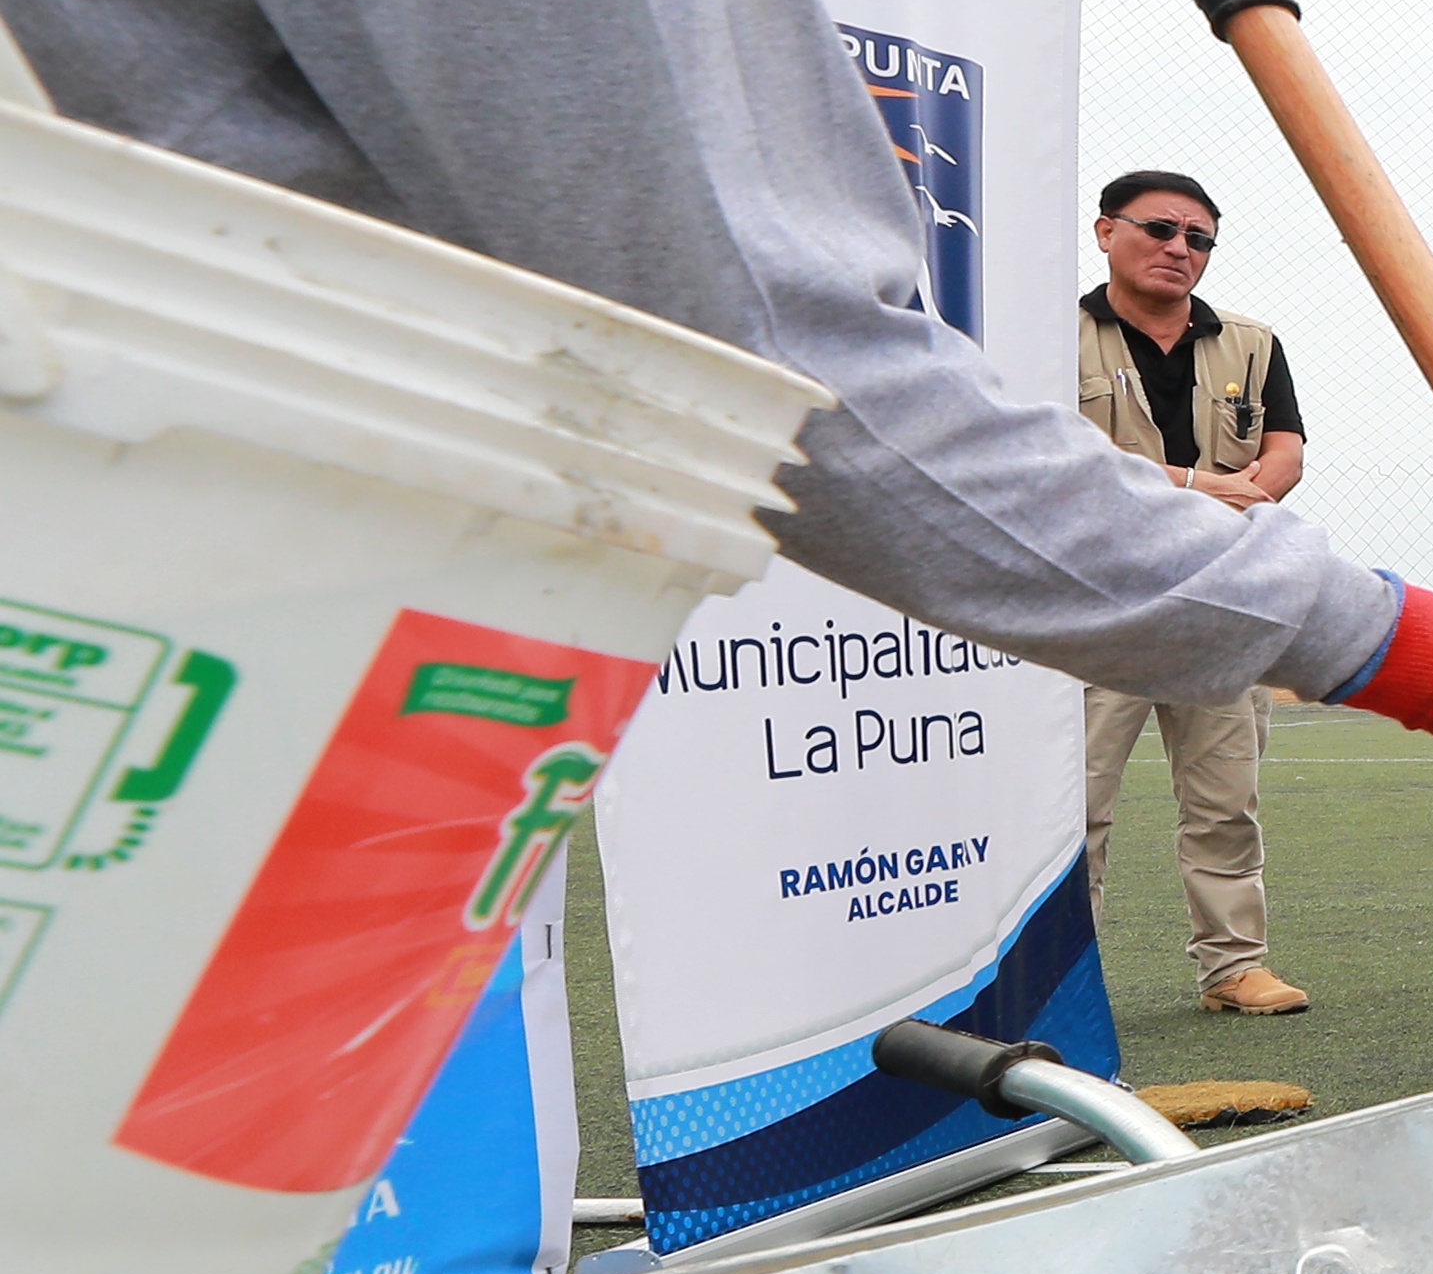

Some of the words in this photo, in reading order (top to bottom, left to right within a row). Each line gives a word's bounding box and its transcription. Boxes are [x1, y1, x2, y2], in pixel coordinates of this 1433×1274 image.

[764, 717, 839, 780] La
[855, 709, 985, 770] Puna
[779, 846, 899, 899] RAMÓN
[847, 879, 960, 923] ALCALDE
